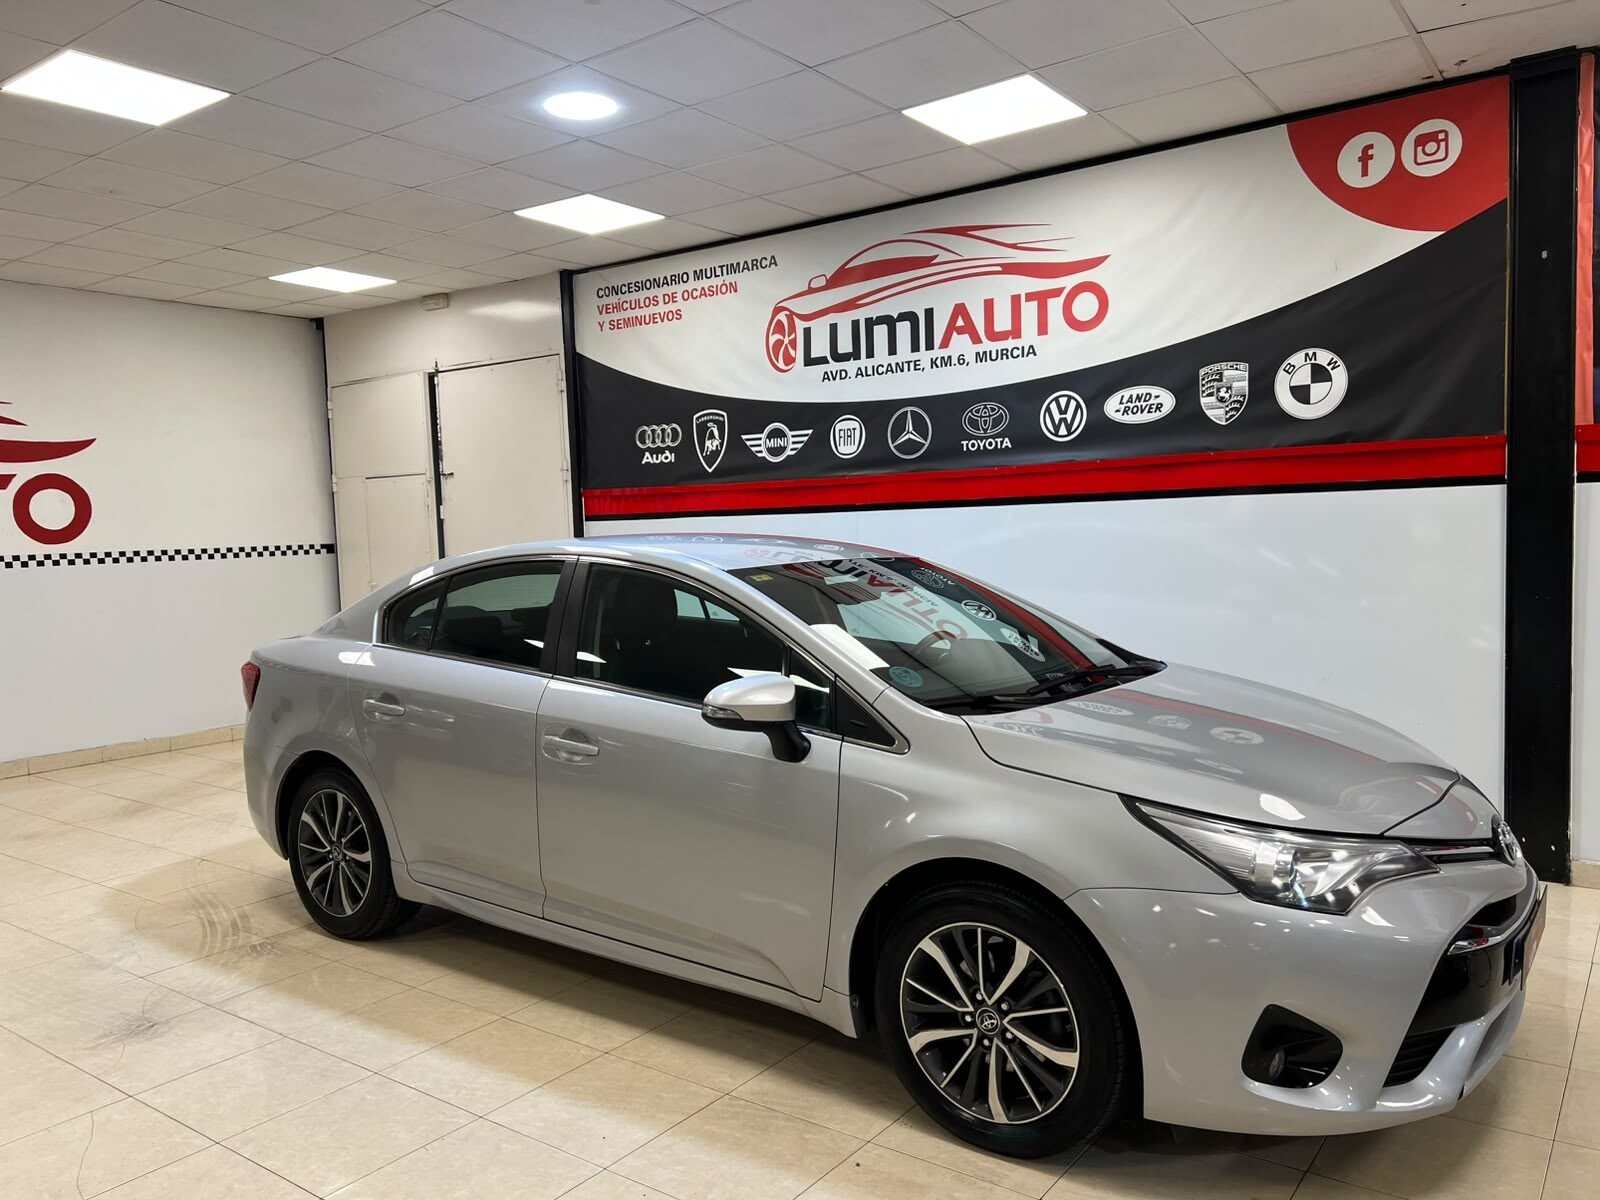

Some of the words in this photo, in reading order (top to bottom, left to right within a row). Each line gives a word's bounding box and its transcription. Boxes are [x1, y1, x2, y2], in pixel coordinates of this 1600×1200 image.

[596, 271, 690, 298] CONCESIONARIO
[693, 255, 778, 282] MULTIMARCA
[597, 295, 660, 316] VEHÍCULOS
[663, 291, 678, 306] DE
[681, 280, 738, 302] OCASIÓN
[598, 321, 605, 332] Y
[608, 308, 683, 331] SEMINUEVOS
[821, 370, 852, 383] AVD.
[855, 359, 926, 379] ALICANTE,
[930, 354, 970, 370] KM.6,
[975, 344, 1038, 365] MURCIA
[1201, 363, 1246, 375] PORSCHE
[1282, 351, 1341, 375] BMW
[766, 437, 788, 449] MINI
[838, 427, 858, 447] FIAT
[961, 437, 1012, 452] TOYOTA
[641, 451, 675, 464] Audi
